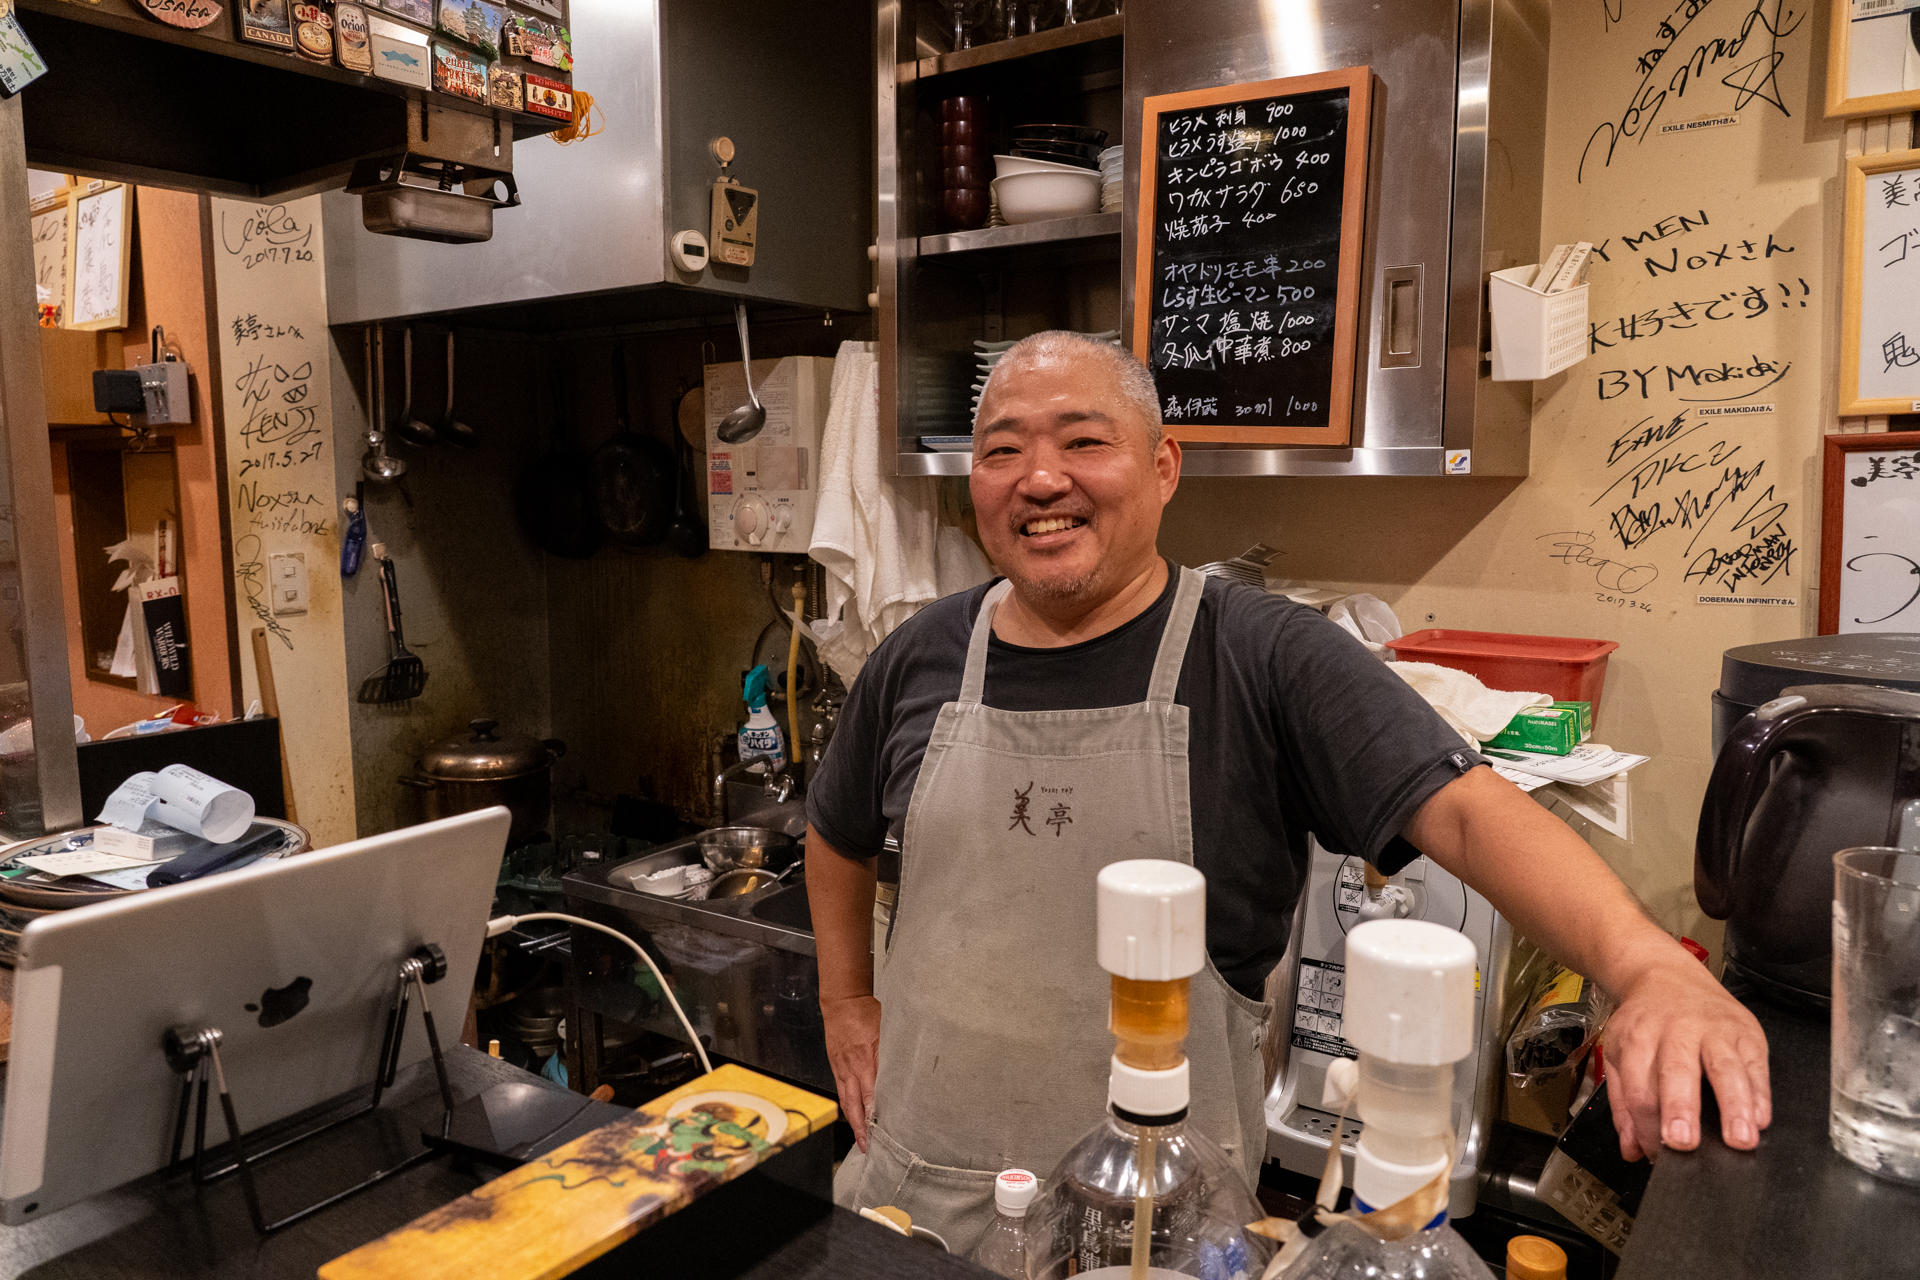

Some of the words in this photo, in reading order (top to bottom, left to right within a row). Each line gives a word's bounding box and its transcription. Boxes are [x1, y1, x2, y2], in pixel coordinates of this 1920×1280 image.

[248, 28, 291, 45] CANADA
[341, 18, 366, 33] Orion
[436, 60, 472, 83] MARKET
[445, 56, 476, 71] PUBLIC
[444, 79, 479, 98] CENTER
[534, 76, 566, 90] HINANO
[535, 104, 567, 119] TAHITI
[1169, 113, 1208, 135] ヒラメ
[1215, 105, 1246, 128] 刺身
[1266, 102, 1294, 123] 900
[1661, 123, 1685, 133] EXILE
[1686, 116, 1736, 130] NESMITHさん
[1273, 126, 1307, 146] 1000
[1168, 153, 1283, 185] キンピラゴボウ
[1295, 150, 1330, 170] 400
[1168, 182, 1271, 213] ワカメサラダ
[1280, 176, 1319, 204] 650
[1165, 214, 1231, 242] 焼茄子
[1241, 211, 1277, 228] 400
[1621, 210, 1710, 252] MEN
[1165, 254, 1282, 284] オヤドリモモ串
[1286, 259, 1327, 273] 200
[1163, 281, 1270, 310] しらす生ピーマン
[1277, 285, 1315, 306] 500
[1162, 313, 1210, 337] サンマ
[1278, 311, 1315, 335] 1000
[1281, 337, 1312, 358] 800
[1598, 365, 1658, 400] BY
[1164, 394, 1218, 419] 森伊蔵
[1286, 395, 1318, 417] 1000
[1699, 408, 1723, 416] EXILE
[1723, 404, 1773, 415] MAKIDAIさん
[239, 441, 323, 477] 2017.5.27
[1699, 596, 1745, 605] DOBERMAN
[1746, 597, 1795, 606] INFINITYさん
[1527, 719, 1557, 727] AsahiKASEI
